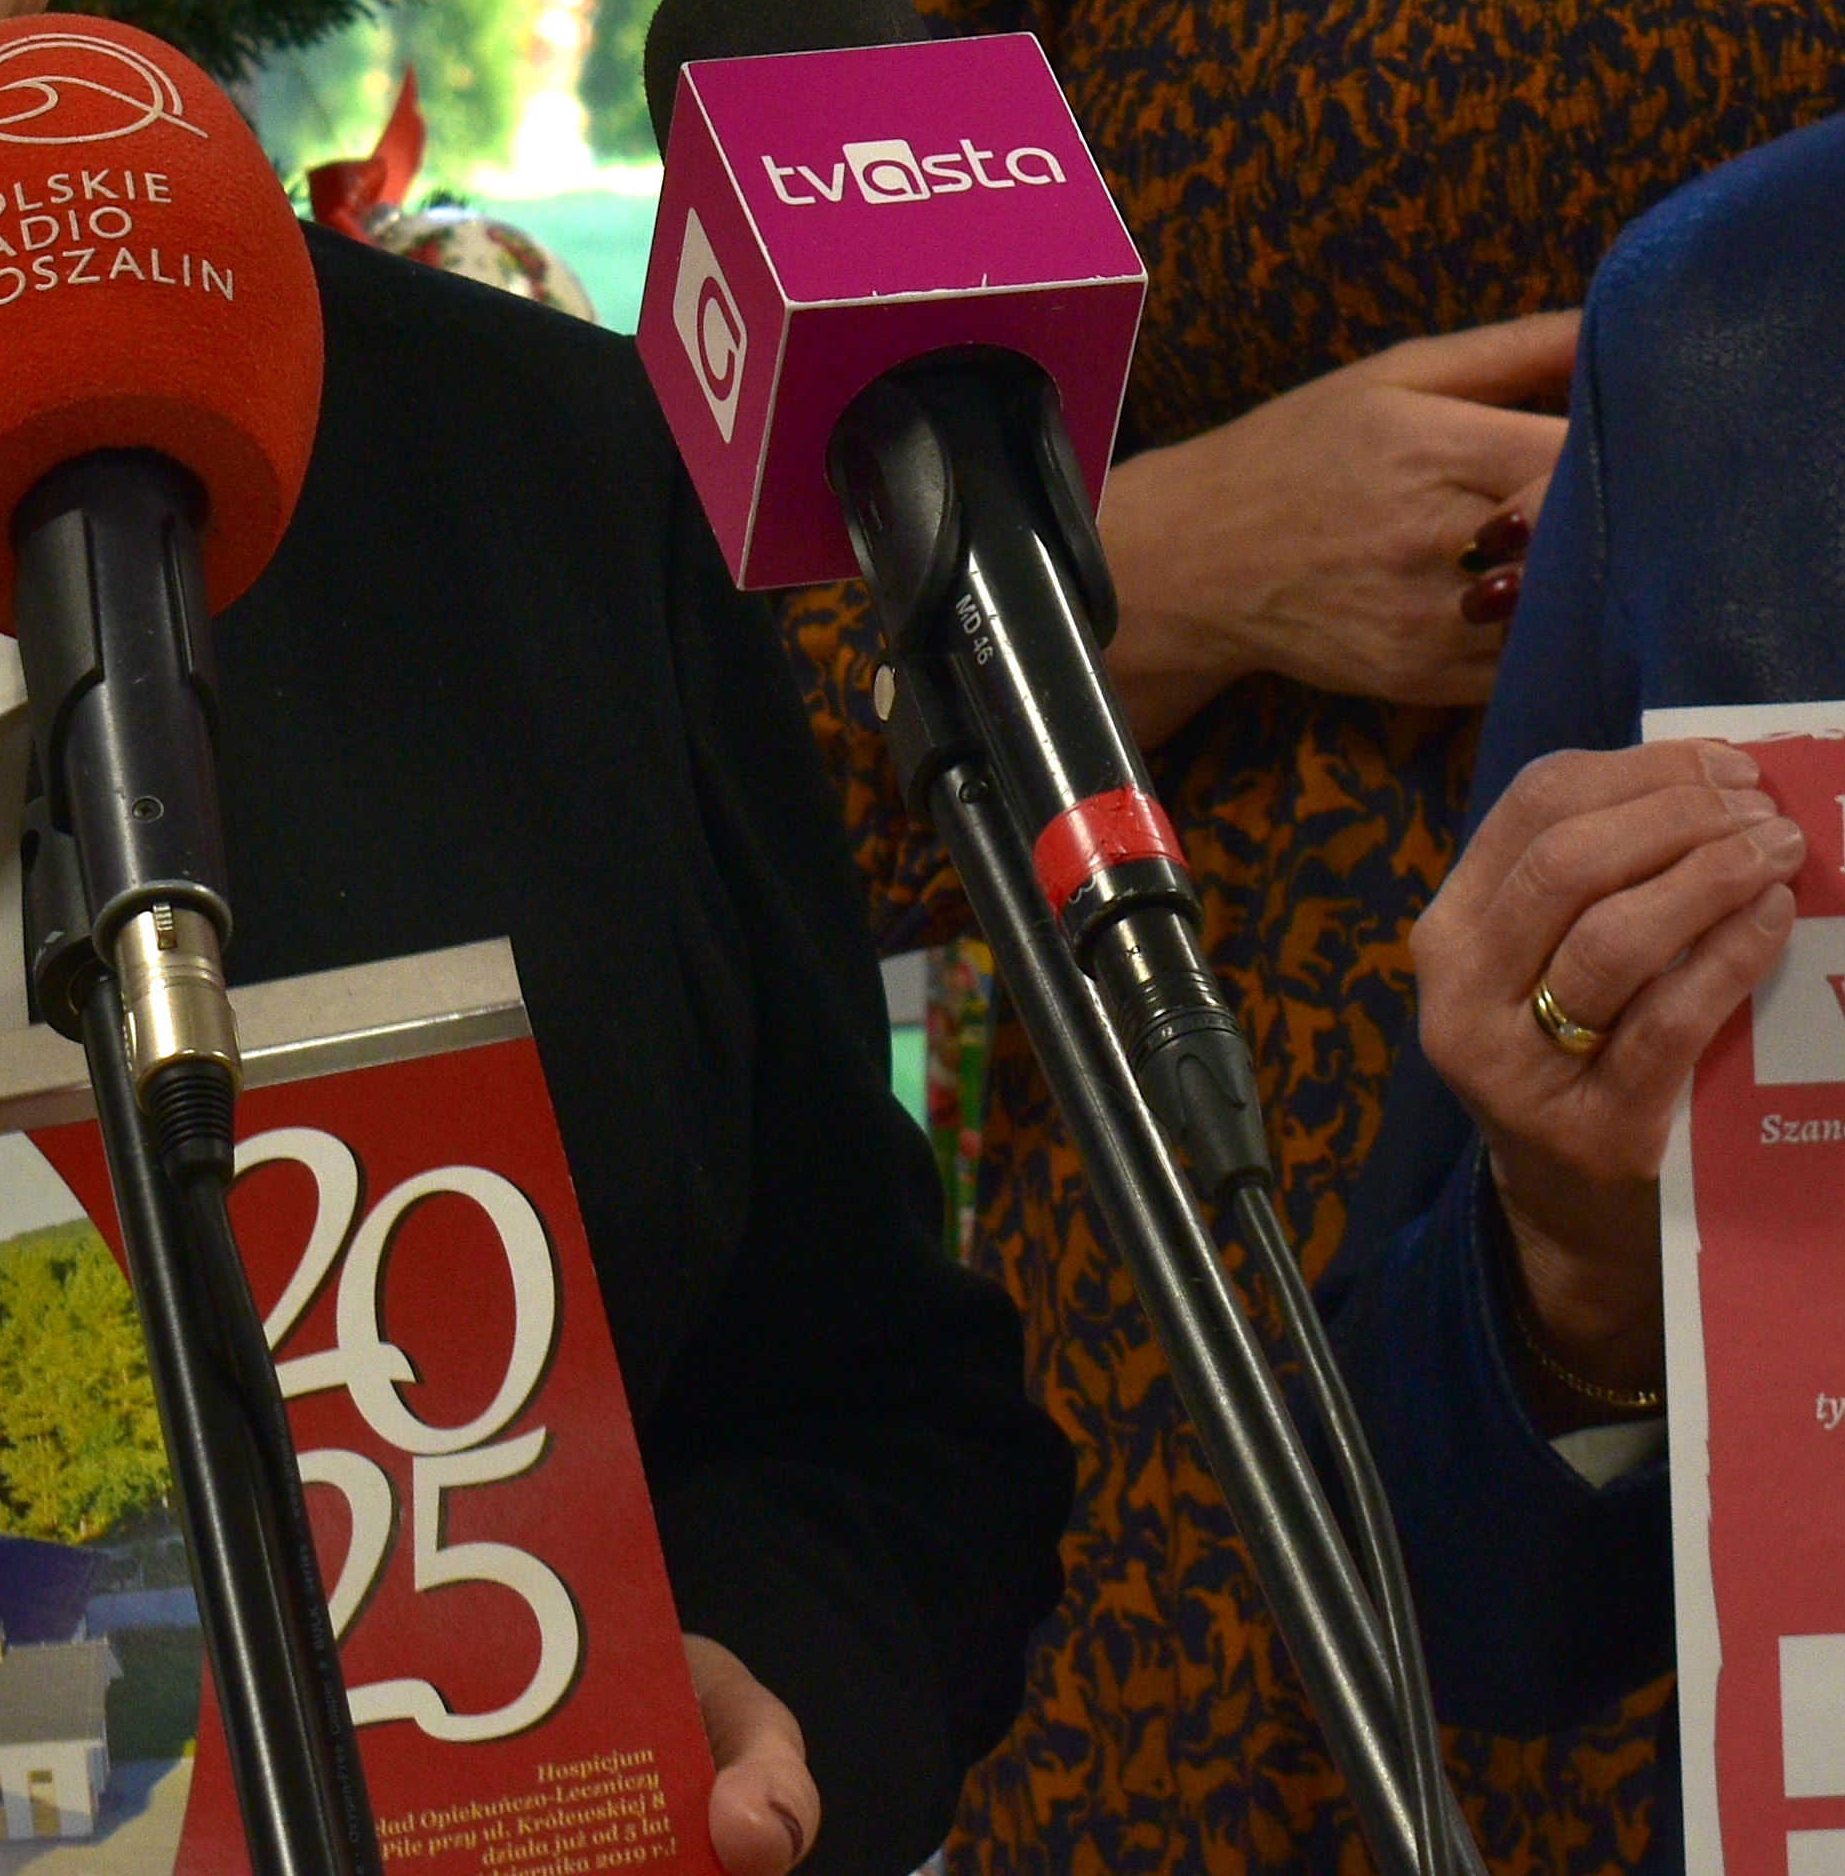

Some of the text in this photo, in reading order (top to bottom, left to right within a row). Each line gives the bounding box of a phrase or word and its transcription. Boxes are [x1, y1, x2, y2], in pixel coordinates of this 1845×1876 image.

[954, 593, 995, 666] MD 46
[309, 1604, 327, 1652] BULK
[537, 1748, 655, 1783] Hospicjum
[381, 1837, 424, 1862] Pile
[428, 1830, 477, 1857] przy
[482, 1819, 512, 1842] ul.
[517, 1792, 647, 1835] Królewskiej
[552, 1829, 587, 1858] już
[592, 1822, 620, 1846] od
[641, 1815, 672, 1837] lat
[595, 1845, 648, 1870] 2019
